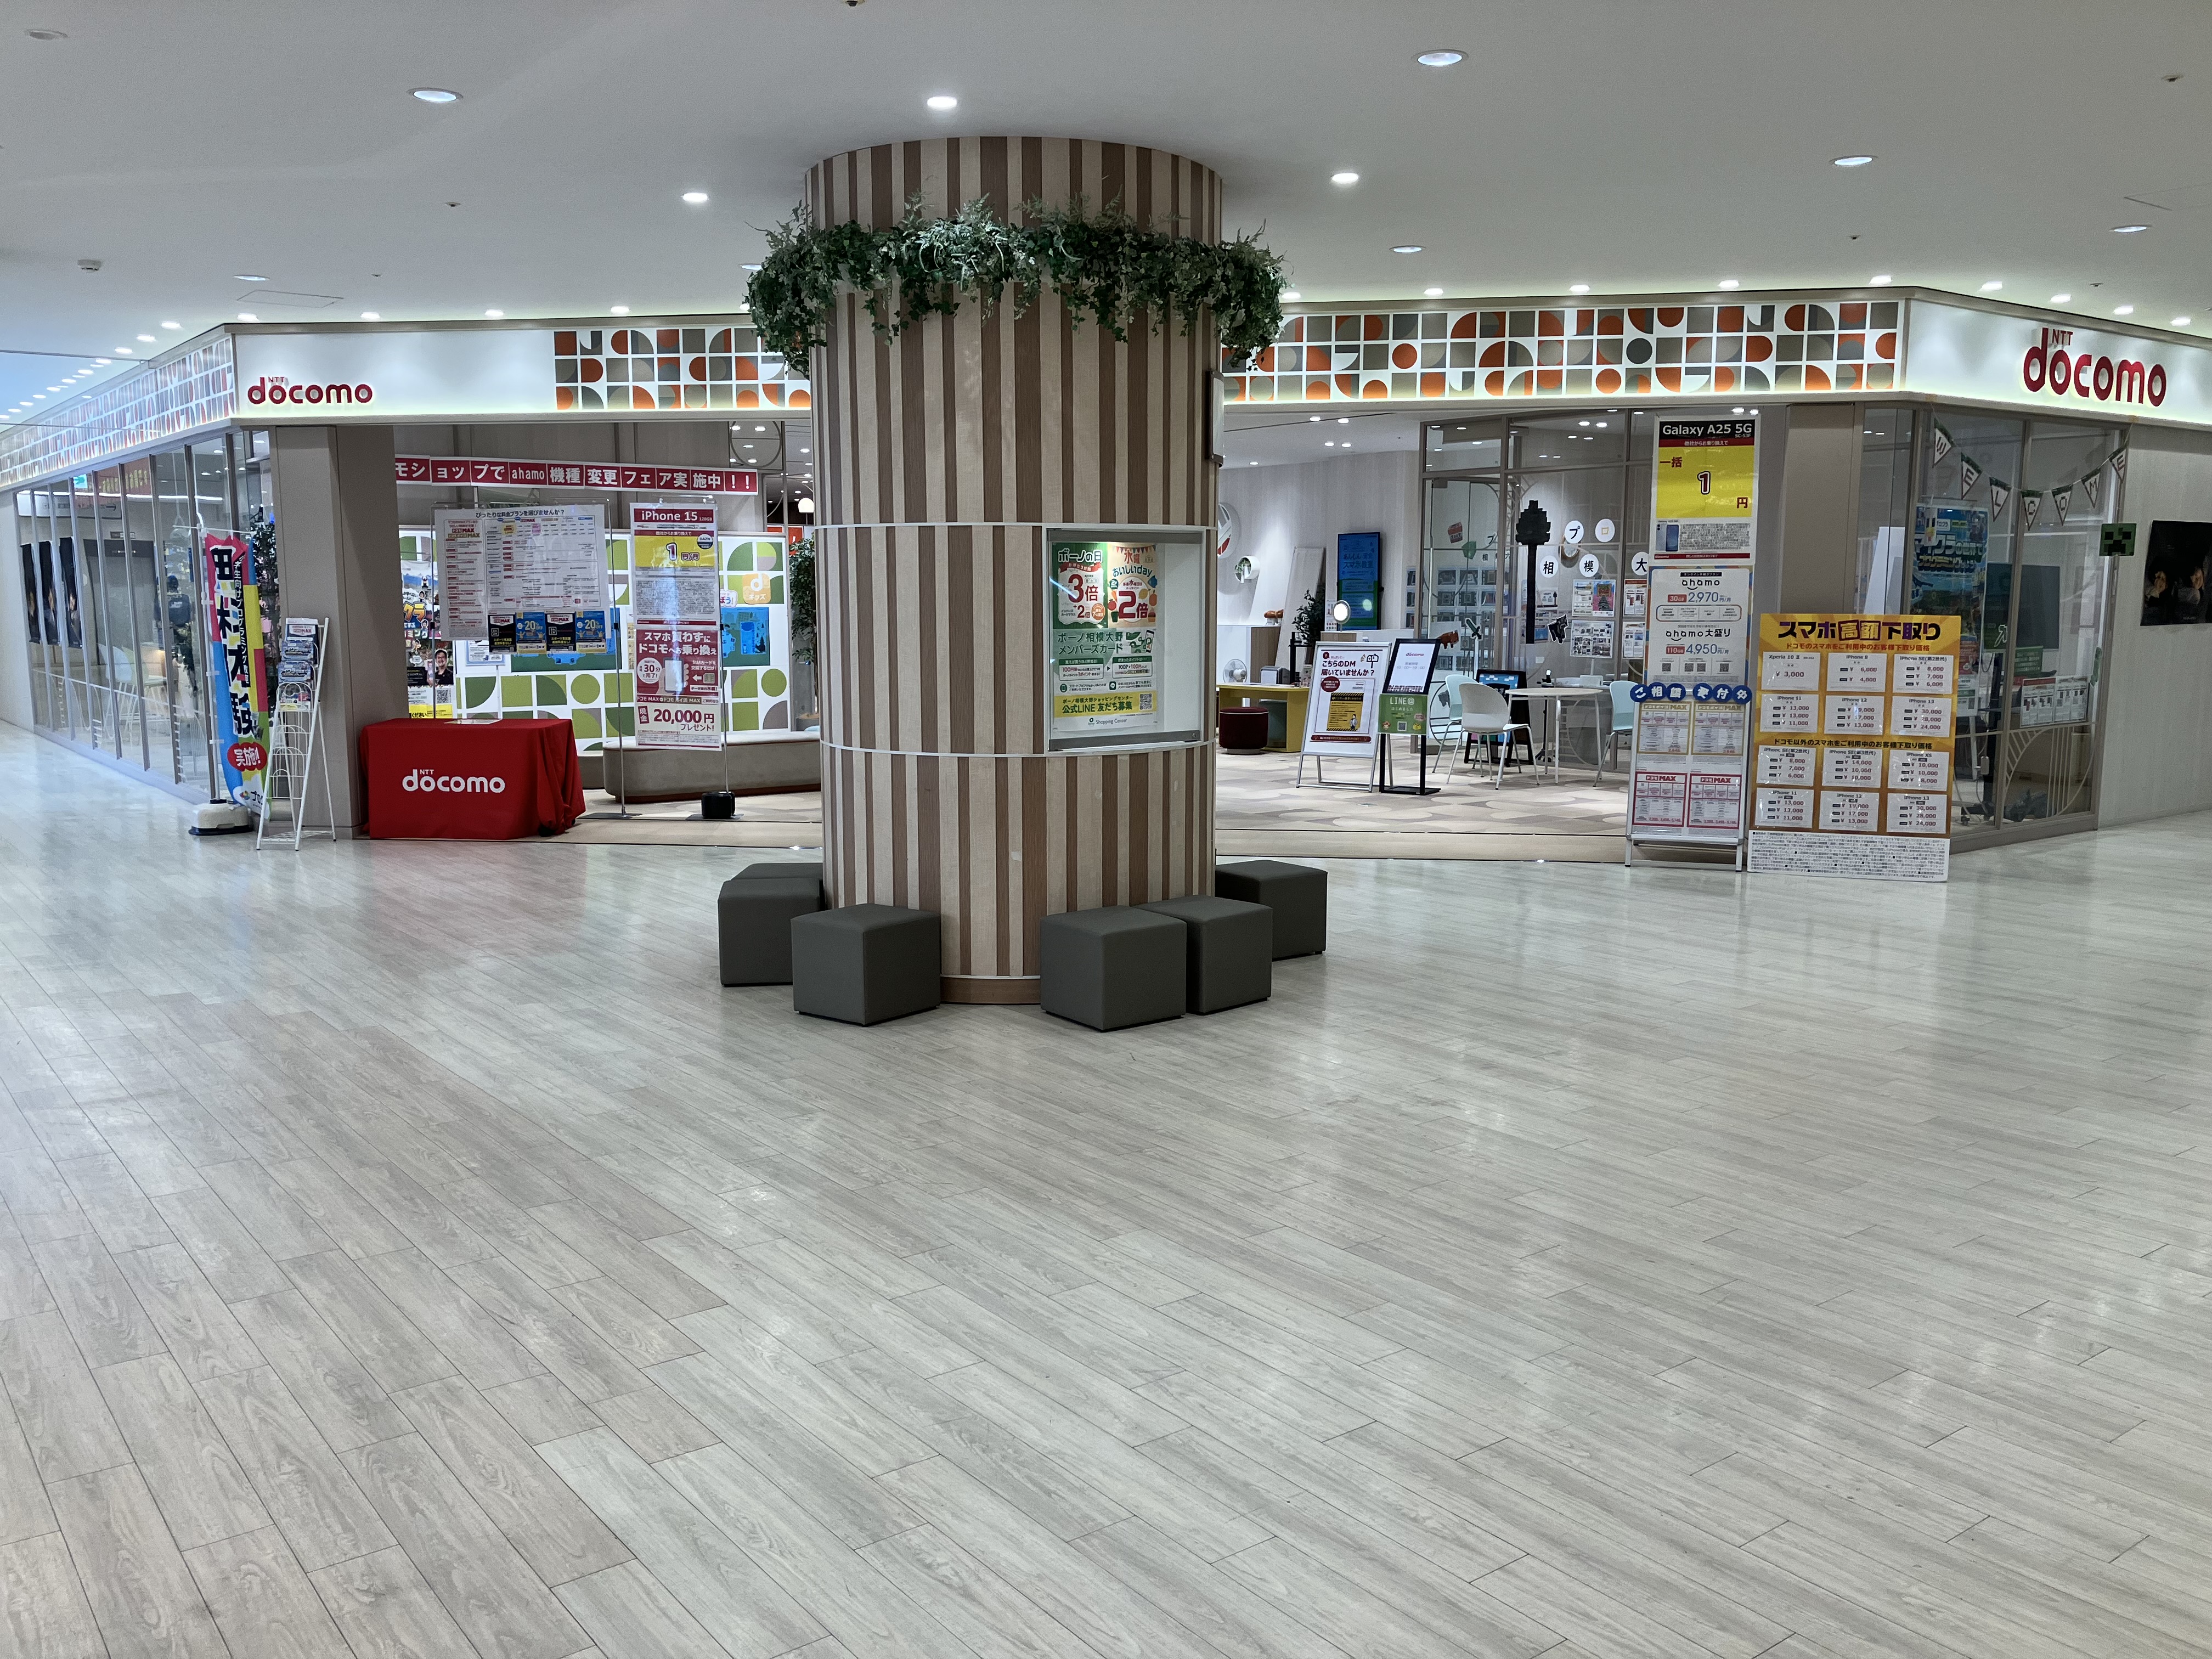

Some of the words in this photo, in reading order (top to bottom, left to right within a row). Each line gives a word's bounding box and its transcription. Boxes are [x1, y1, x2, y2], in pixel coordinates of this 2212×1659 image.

[2052, 328, 2074, 346] NTT
[2023, 328, 2167, 407] docomo
[247, 377, 373, 405] docomo
[1662, 425, 1704, 437] Galaxy
[1707, 424, 1731, 434] A25
[1735, 423, 1752, 433] 5G
[1659, 456, 1683, 468] 一括
[1697, 471, 1711, 495] 1
[1736, 497, 1748, 509] 円
[641, 510, 681, 521] iPhone
[684, 511, 698, 521] 15
[666, 542, 677, 561] 1
[1058, 548, 1103, 562] ボーノの日
[1112, 565, 1153, 577] おいしいday
[1681, 578, 1720, 586] ahamo
[1778, 620, 1941, 641] スマホ高額下取り
[1058, 631, 1123, 644] ボーノ相模大野
[1058, 642, 1124, 655] メンバーズカード
[1062, 696, 1133, 704] ボーノ相模大野ショッピングセンター
[1389, 697, 1415, 706] LINE@
[1062, 704, 1096, 714] 公式LINE
[1097, 701, 1133, 712] 友だち募集
[680, 724, 715, 732] プレゼント！
[402, 769, 506, 793] docomo
